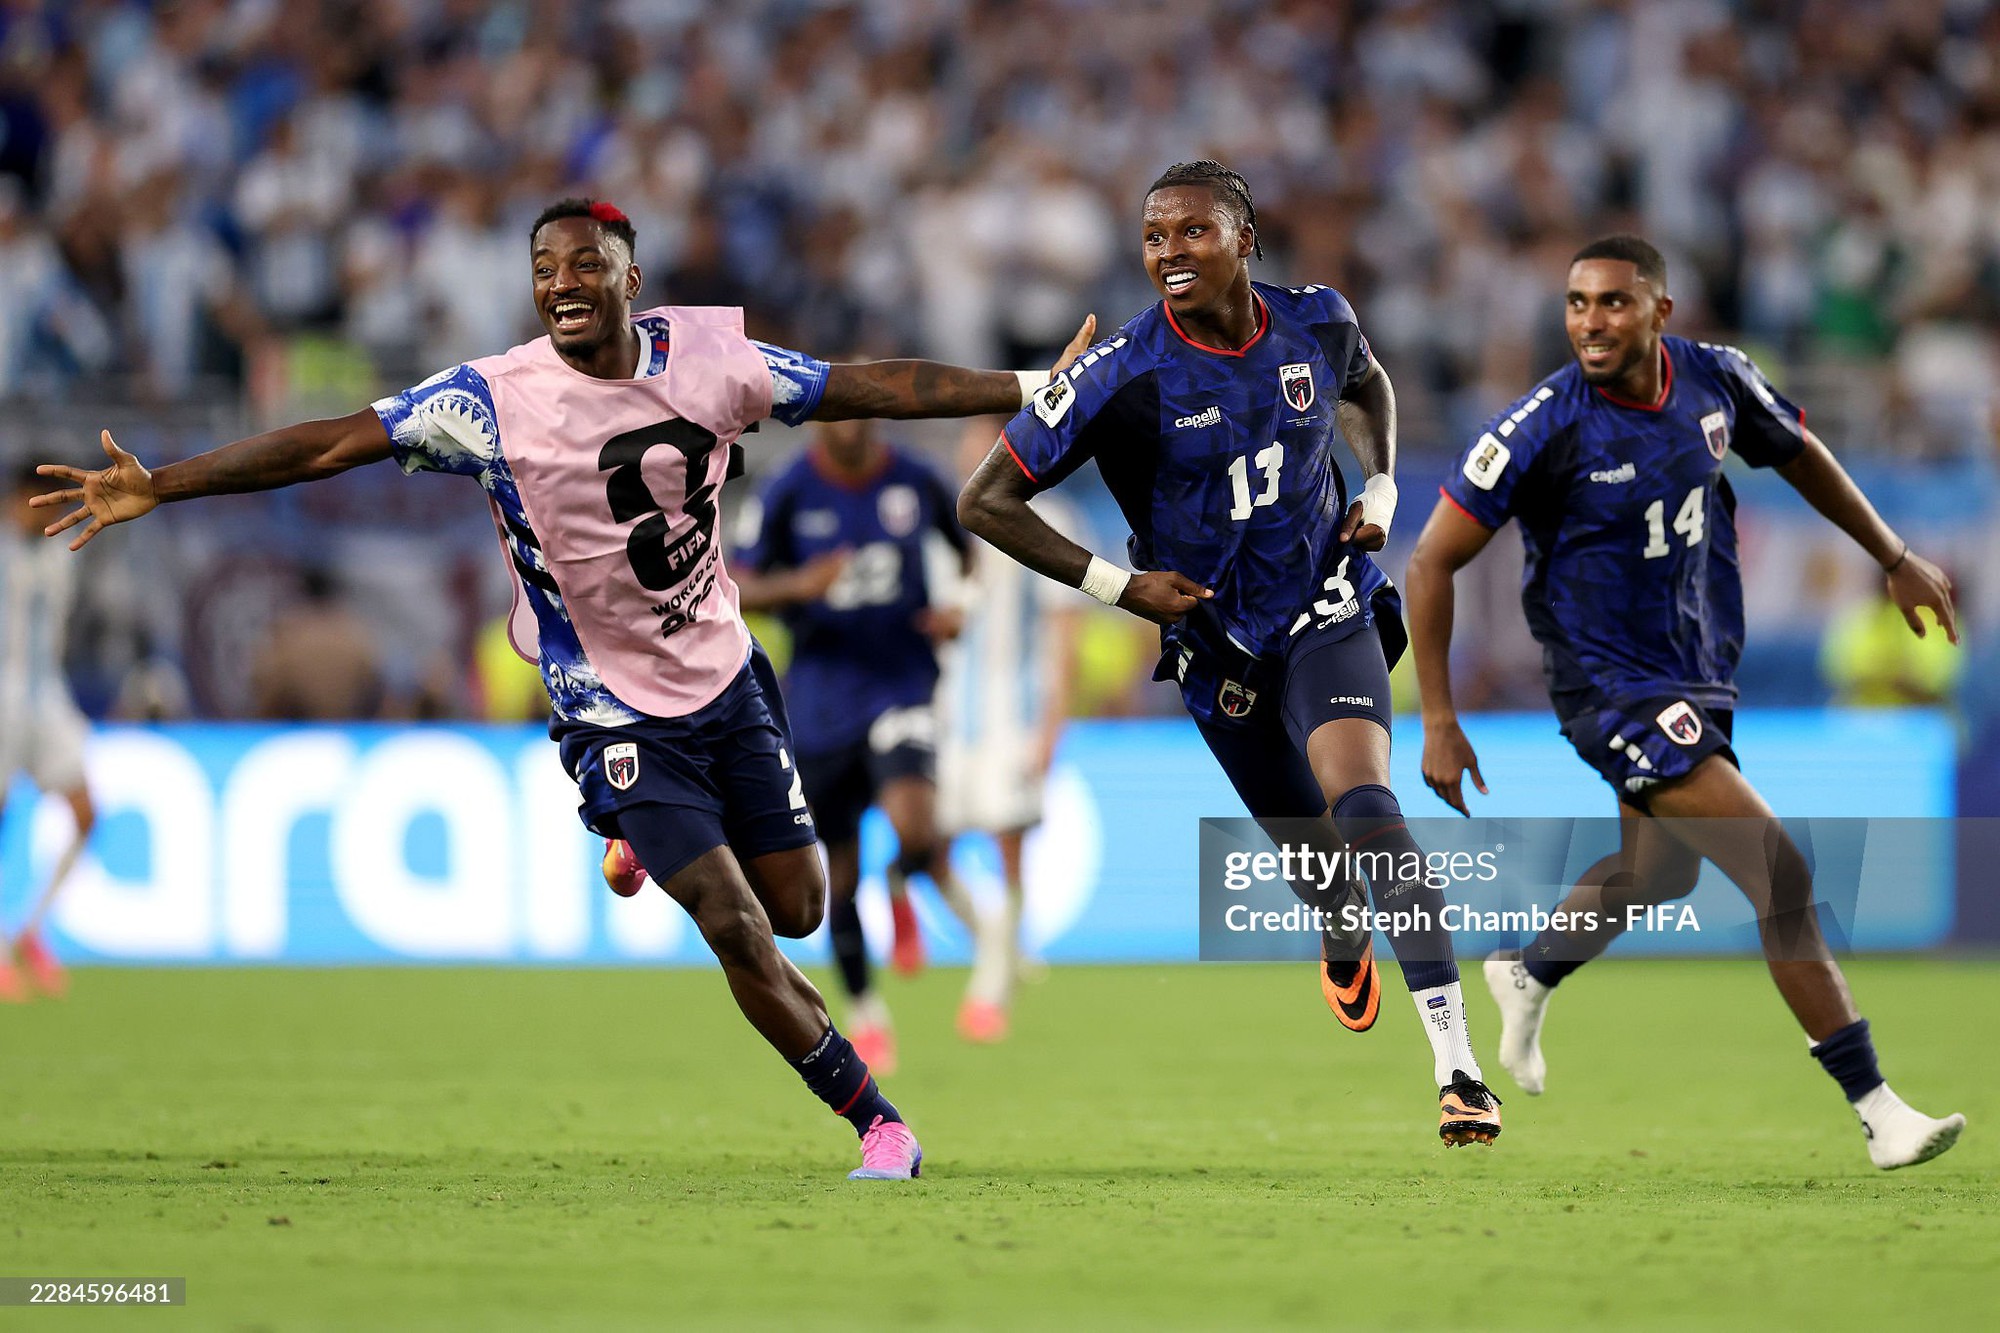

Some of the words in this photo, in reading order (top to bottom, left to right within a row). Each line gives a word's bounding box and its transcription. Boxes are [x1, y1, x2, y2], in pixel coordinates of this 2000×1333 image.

[1282, 365, 1307, 376] FCF
[1175, 406, 1221, 429] capelli
[1198, 417, 1221, 429] SPORT
[1228, 440, 1284, 521] 13
[1644, 486, 1705, 559] 14
[667, 529, 707, 571] FIFA
[651, 570, 705, 617] WORLD
[705, 543, 720, 573] CU
[1289, 555, 1355, 637] 3
[660, 573, 716, 640] 202
[1317, 597, 1359, 630] capelli
[606, 745, 634, 755] FCF
[1430, 1010, 1451, 1023] SLC
[1437, 1020, 1449, 1031] 13
